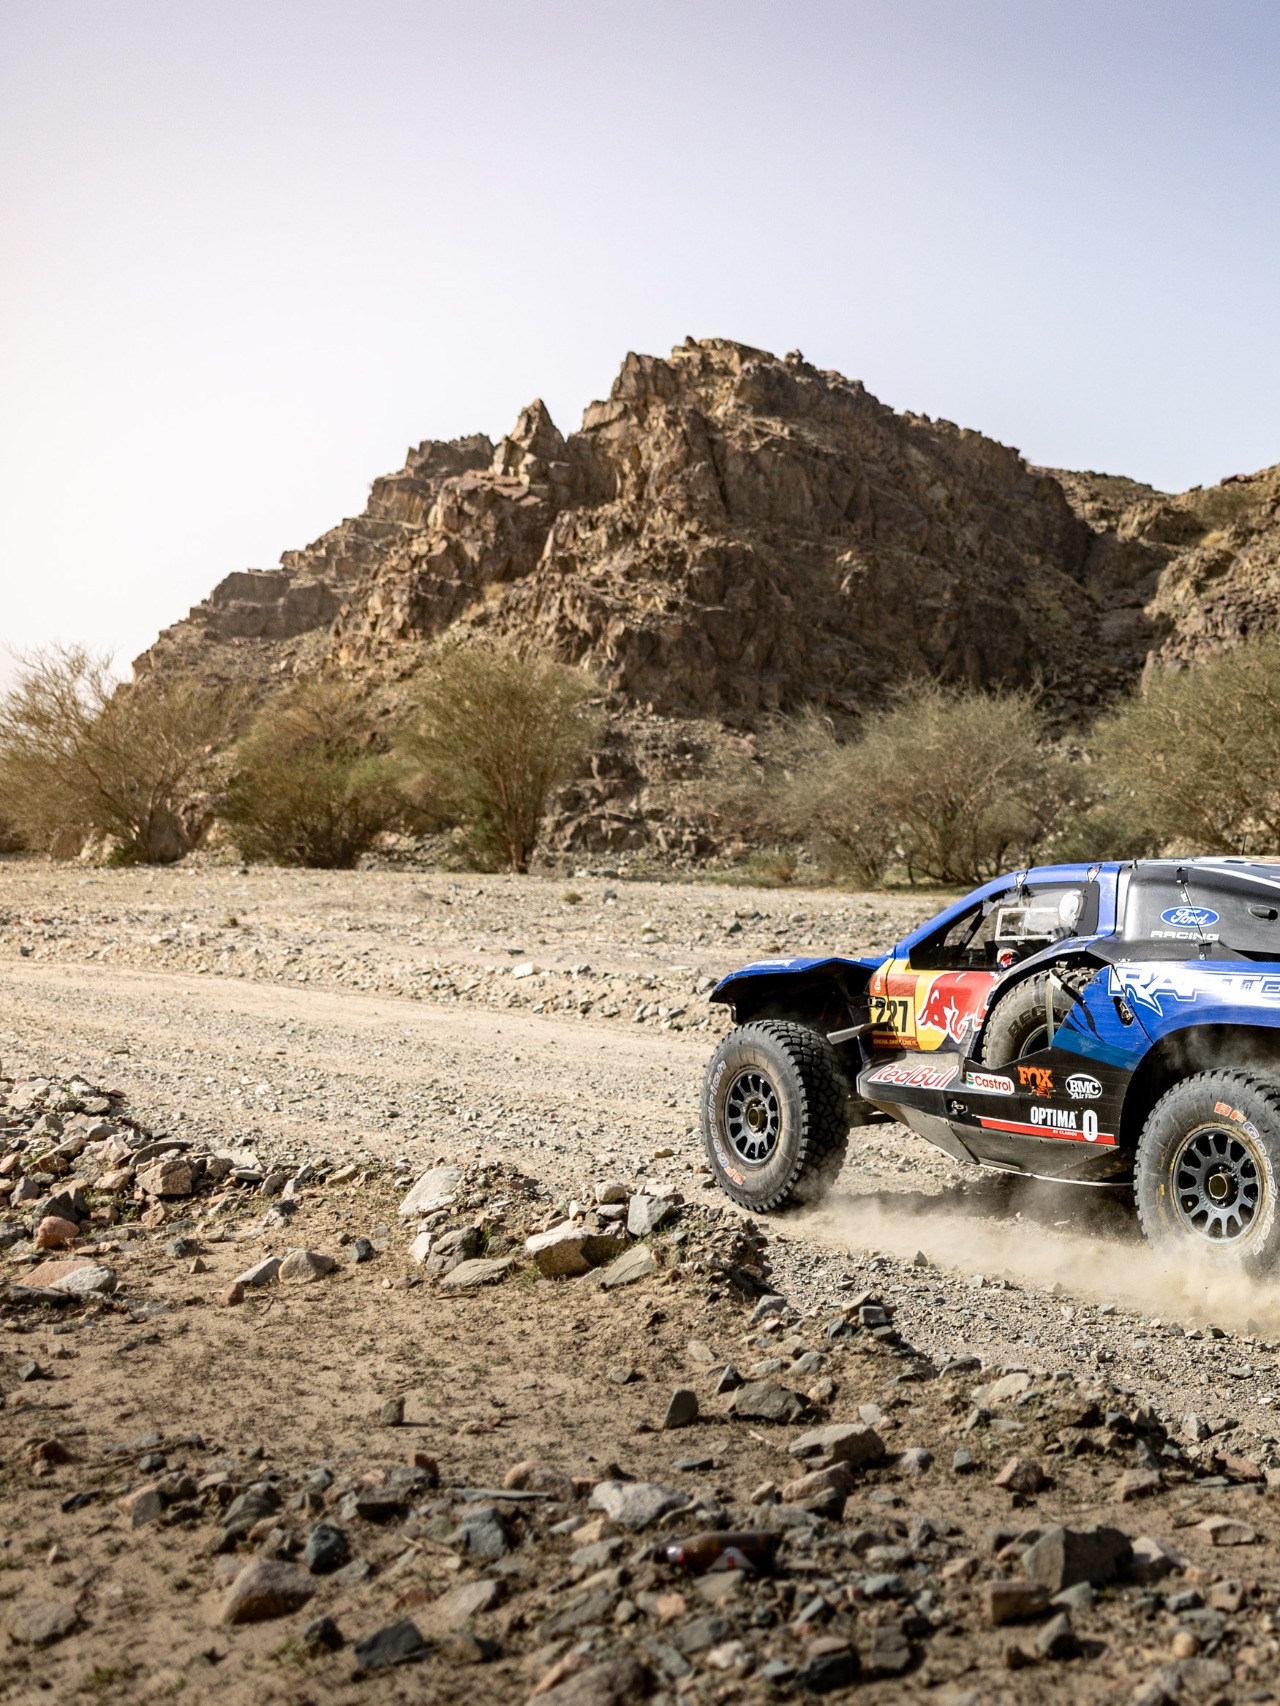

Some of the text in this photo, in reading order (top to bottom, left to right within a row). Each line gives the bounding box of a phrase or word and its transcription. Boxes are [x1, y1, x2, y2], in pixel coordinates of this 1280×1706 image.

[1170, 908, 1209, 925] Ford
[1150, 930, 1219, 941] RACING
[974, 1075, 1012, 1092] Castrol
[1017, 1066, 1054, 1095] FOX
[1069, 1080, 1100, 1095] BMC
[1030, 1106, 1077, 1129] OPTIMA
